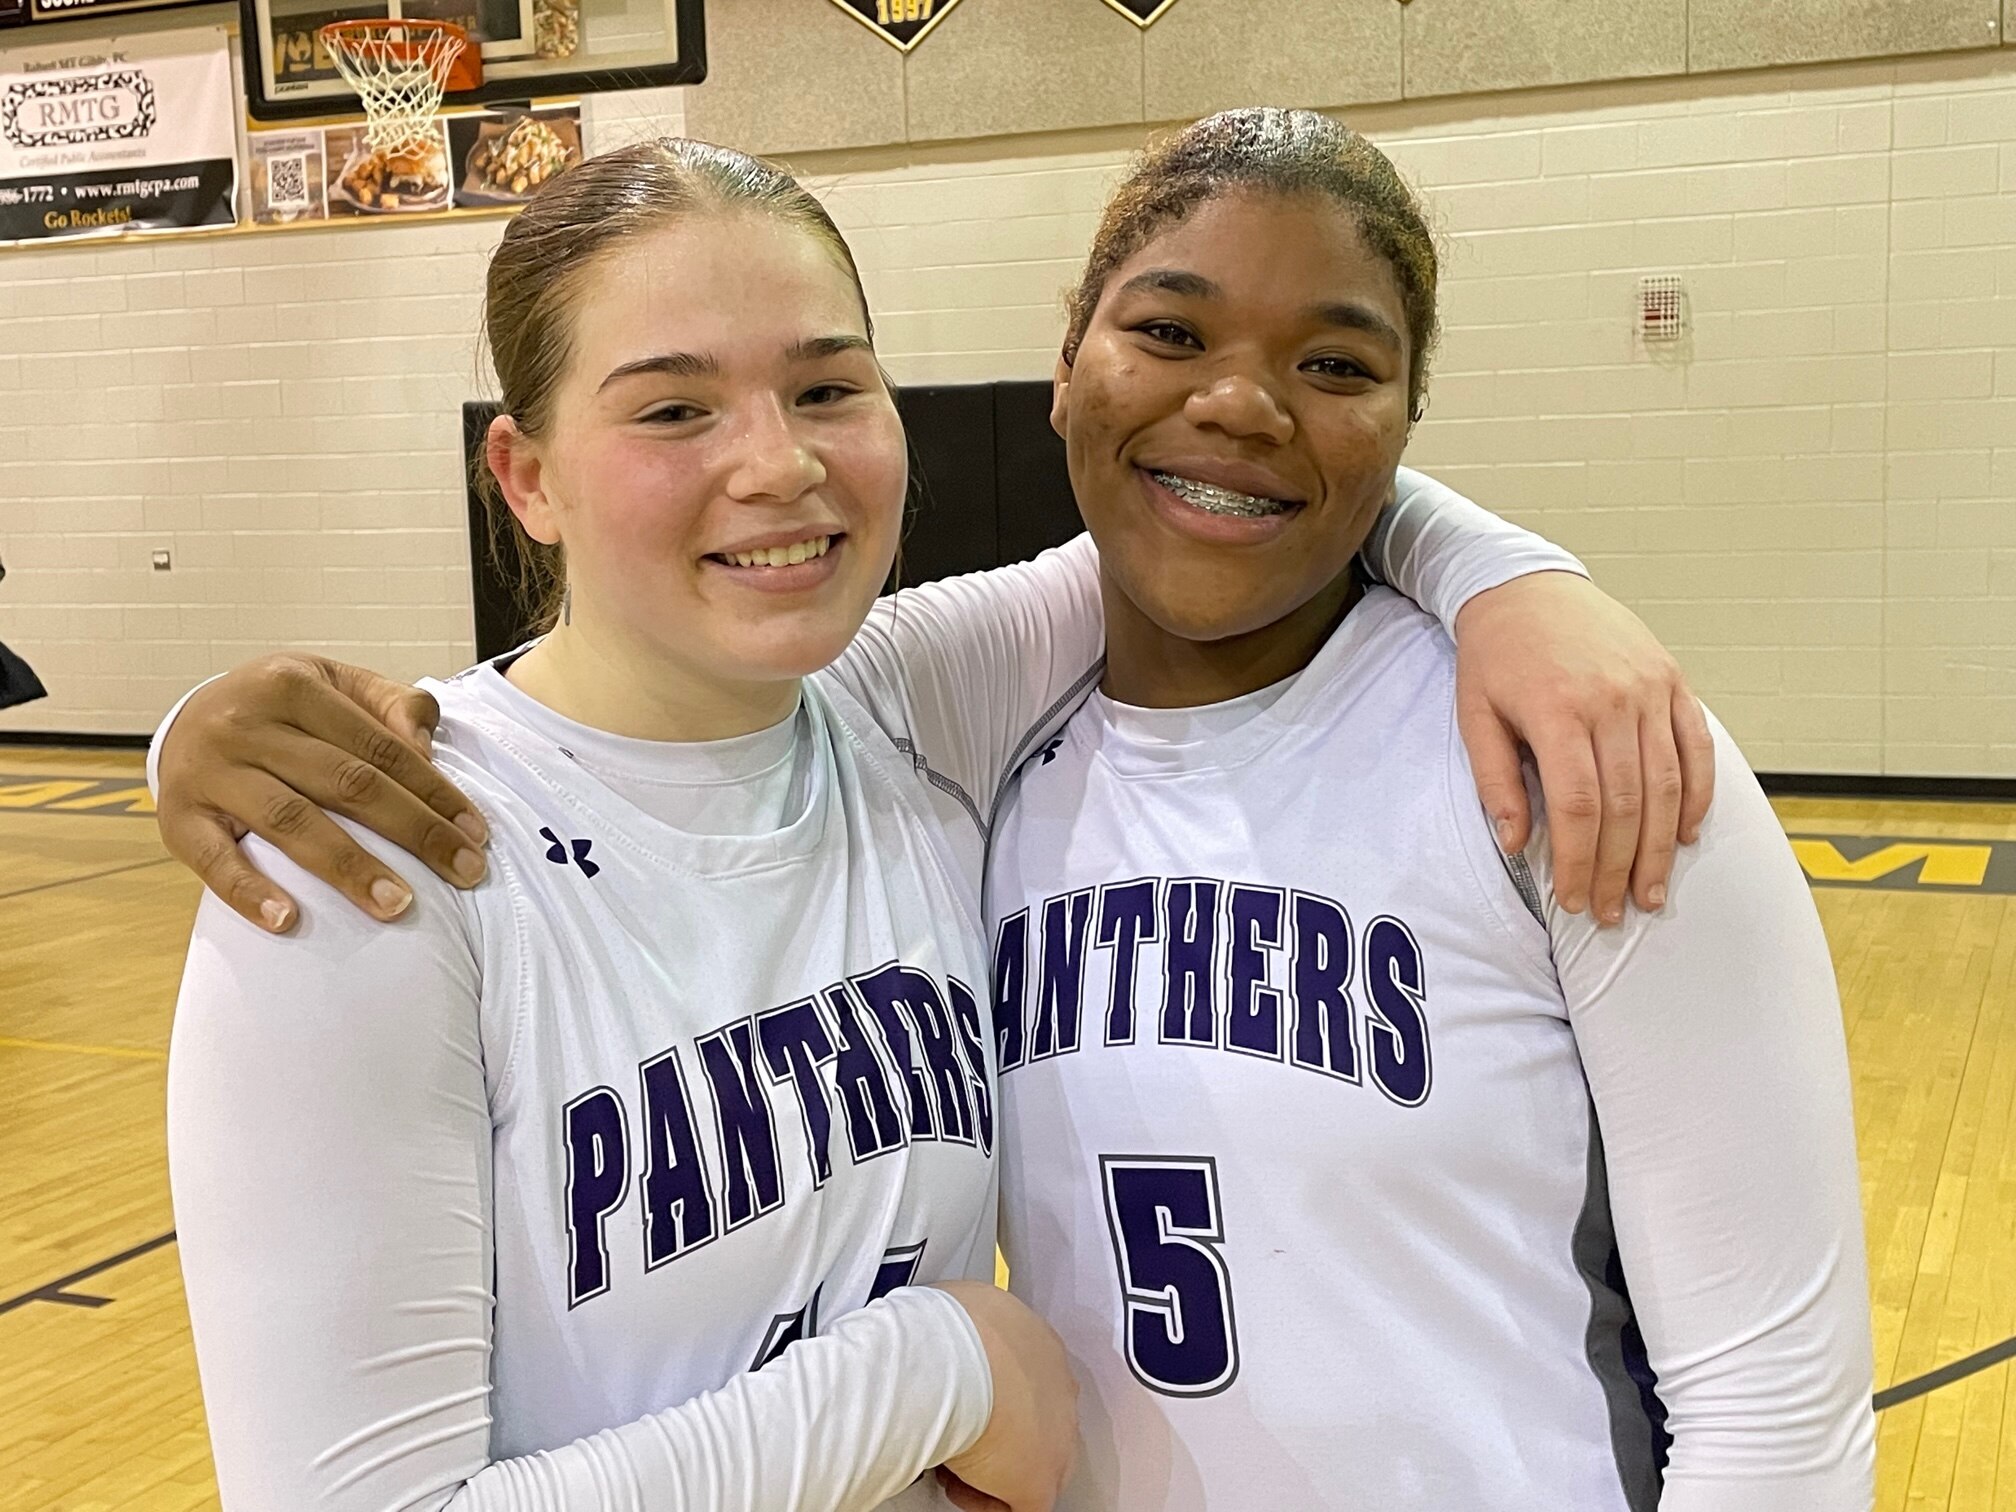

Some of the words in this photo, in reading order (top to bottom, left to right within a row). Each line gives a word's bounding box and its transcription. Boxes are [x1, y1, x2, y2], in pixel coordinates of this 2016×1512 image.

[38, 94, 120, 127] RMTG
[61, 151, 86, 165] Public
[90, 148, 147, 162] Accountants
[75, 175, 200, 199] www.rmtgcpa.com
[44, 210, 67, 229] Go
[70, 205, 132, 228] Rockets!
[991, 877, 1433, 1109] ANTHERS
[563, 959, 994, 1312] PANTHERS
[1099, 1154, 1240, 1399] 5
